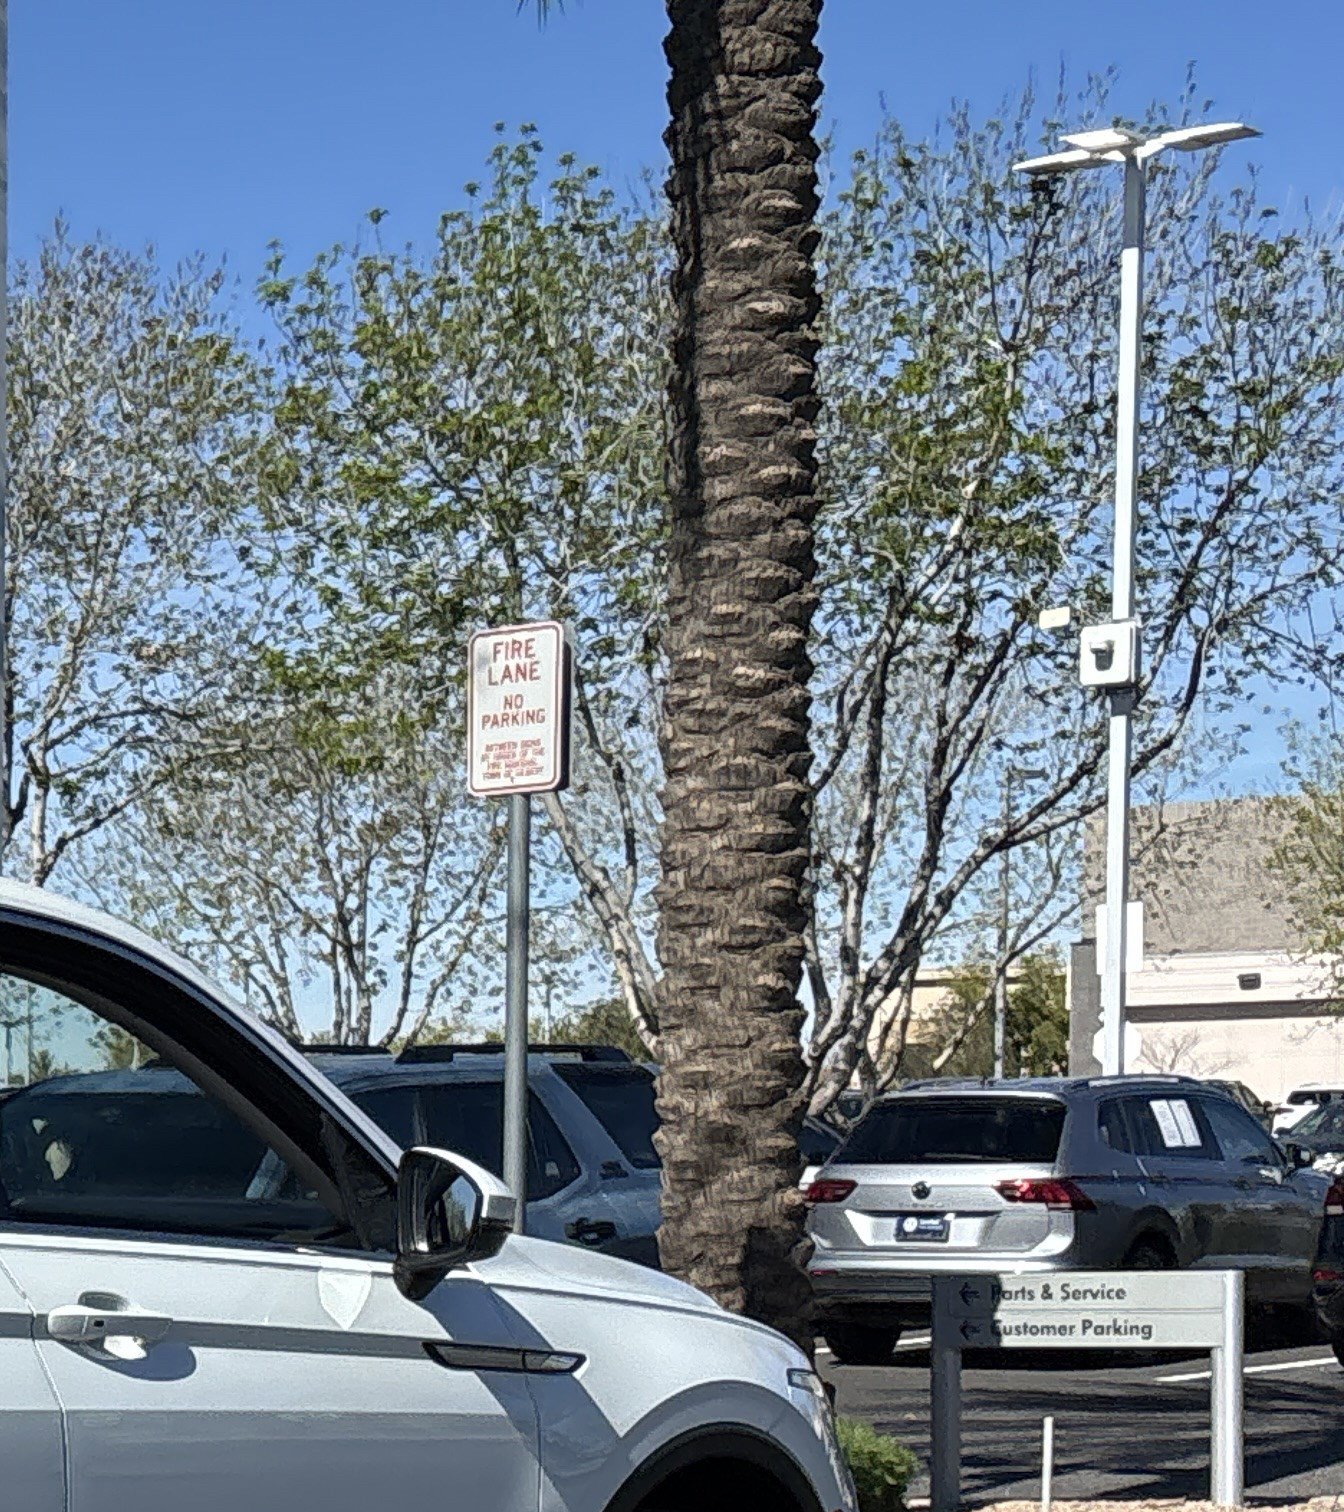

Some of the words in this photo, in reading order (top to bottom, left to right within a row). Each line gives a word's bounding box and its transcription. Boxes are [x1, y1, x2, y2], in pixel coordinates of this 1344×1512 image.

[492, 638, 536, 663] FIRE
[488, 661, 541, 686] LANE
[503, 694, 524, 710] NO
[481, 708, 546, 730] PARKING
[991, 1284, 1035, 1300] Parts
[1040, 1283, 1053, 1300] &
[1060, 1283, 1127, 1301] Service
[991, 1319, 1076, 1336] Customer
[1081, 1319, 1153, 1340] Parking
